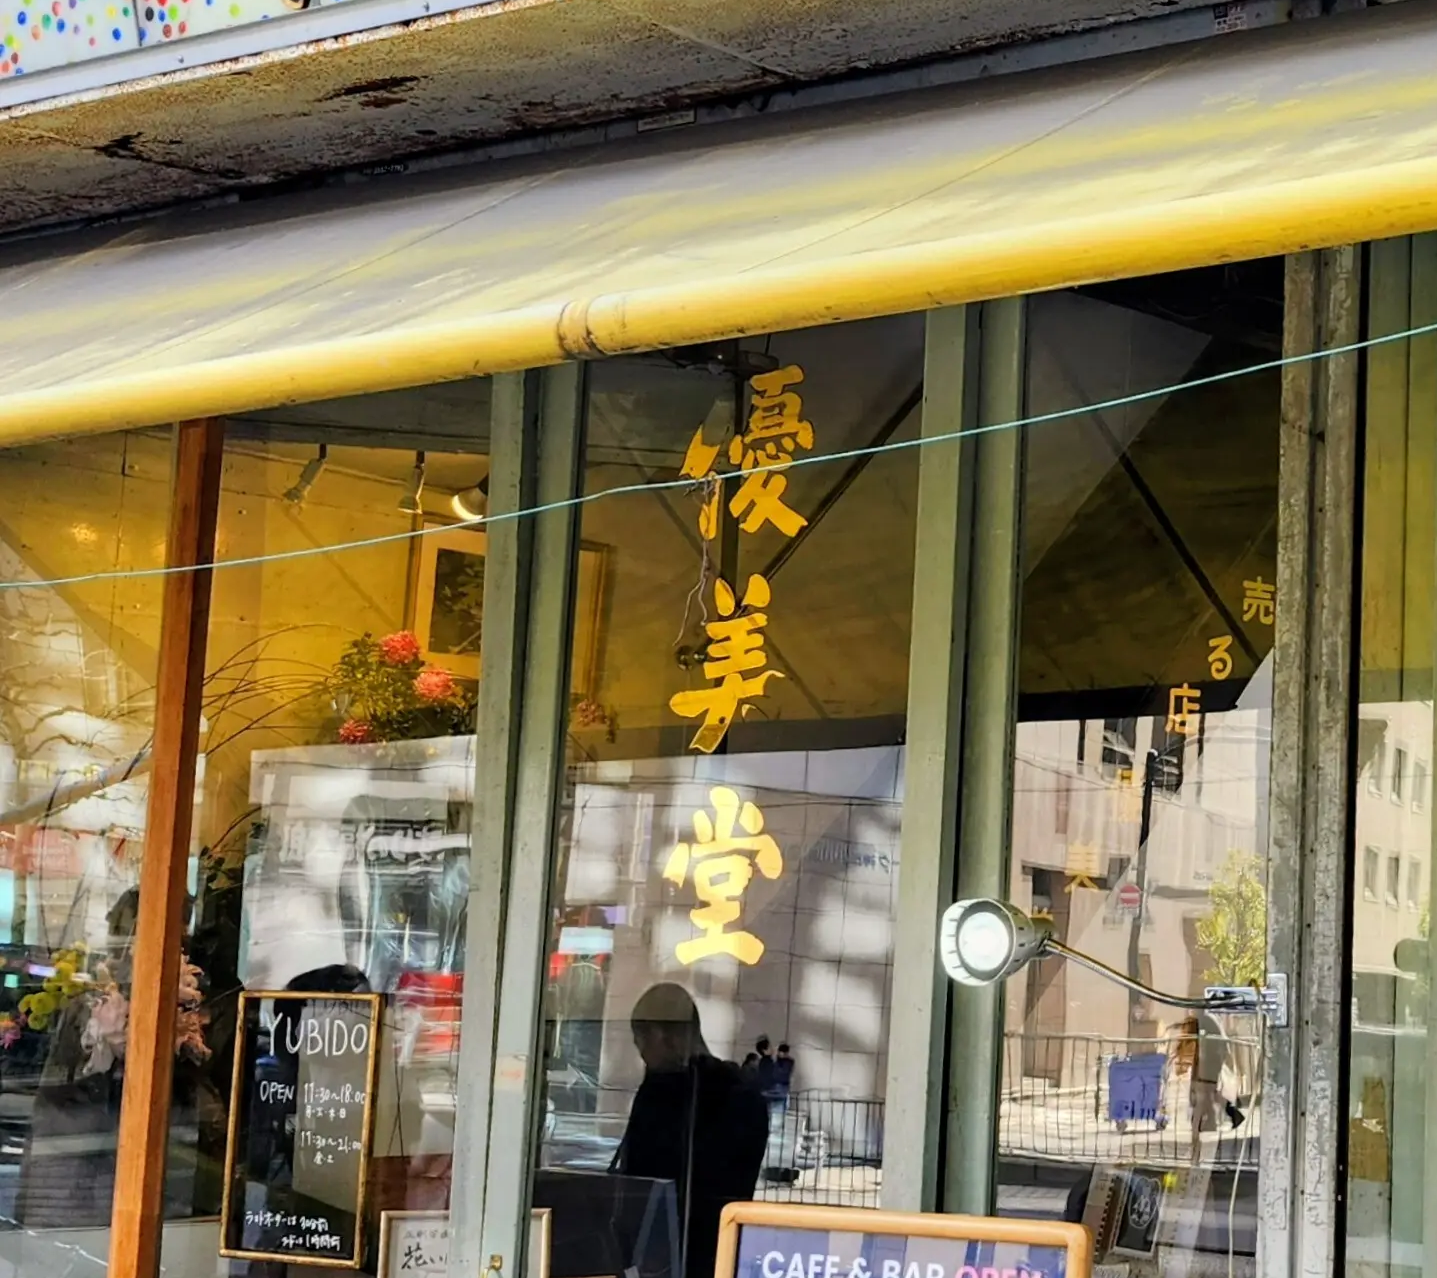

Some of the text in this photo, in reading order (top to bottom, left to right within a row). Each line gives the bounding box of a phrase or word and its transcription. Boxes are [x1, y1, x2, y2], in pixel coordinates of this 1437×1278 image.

[662, 364, 816, 966] 優美堂
[266, 1011, 368, 1057] YUBIDO
[260, 1081, 295, 1104] OPEN
